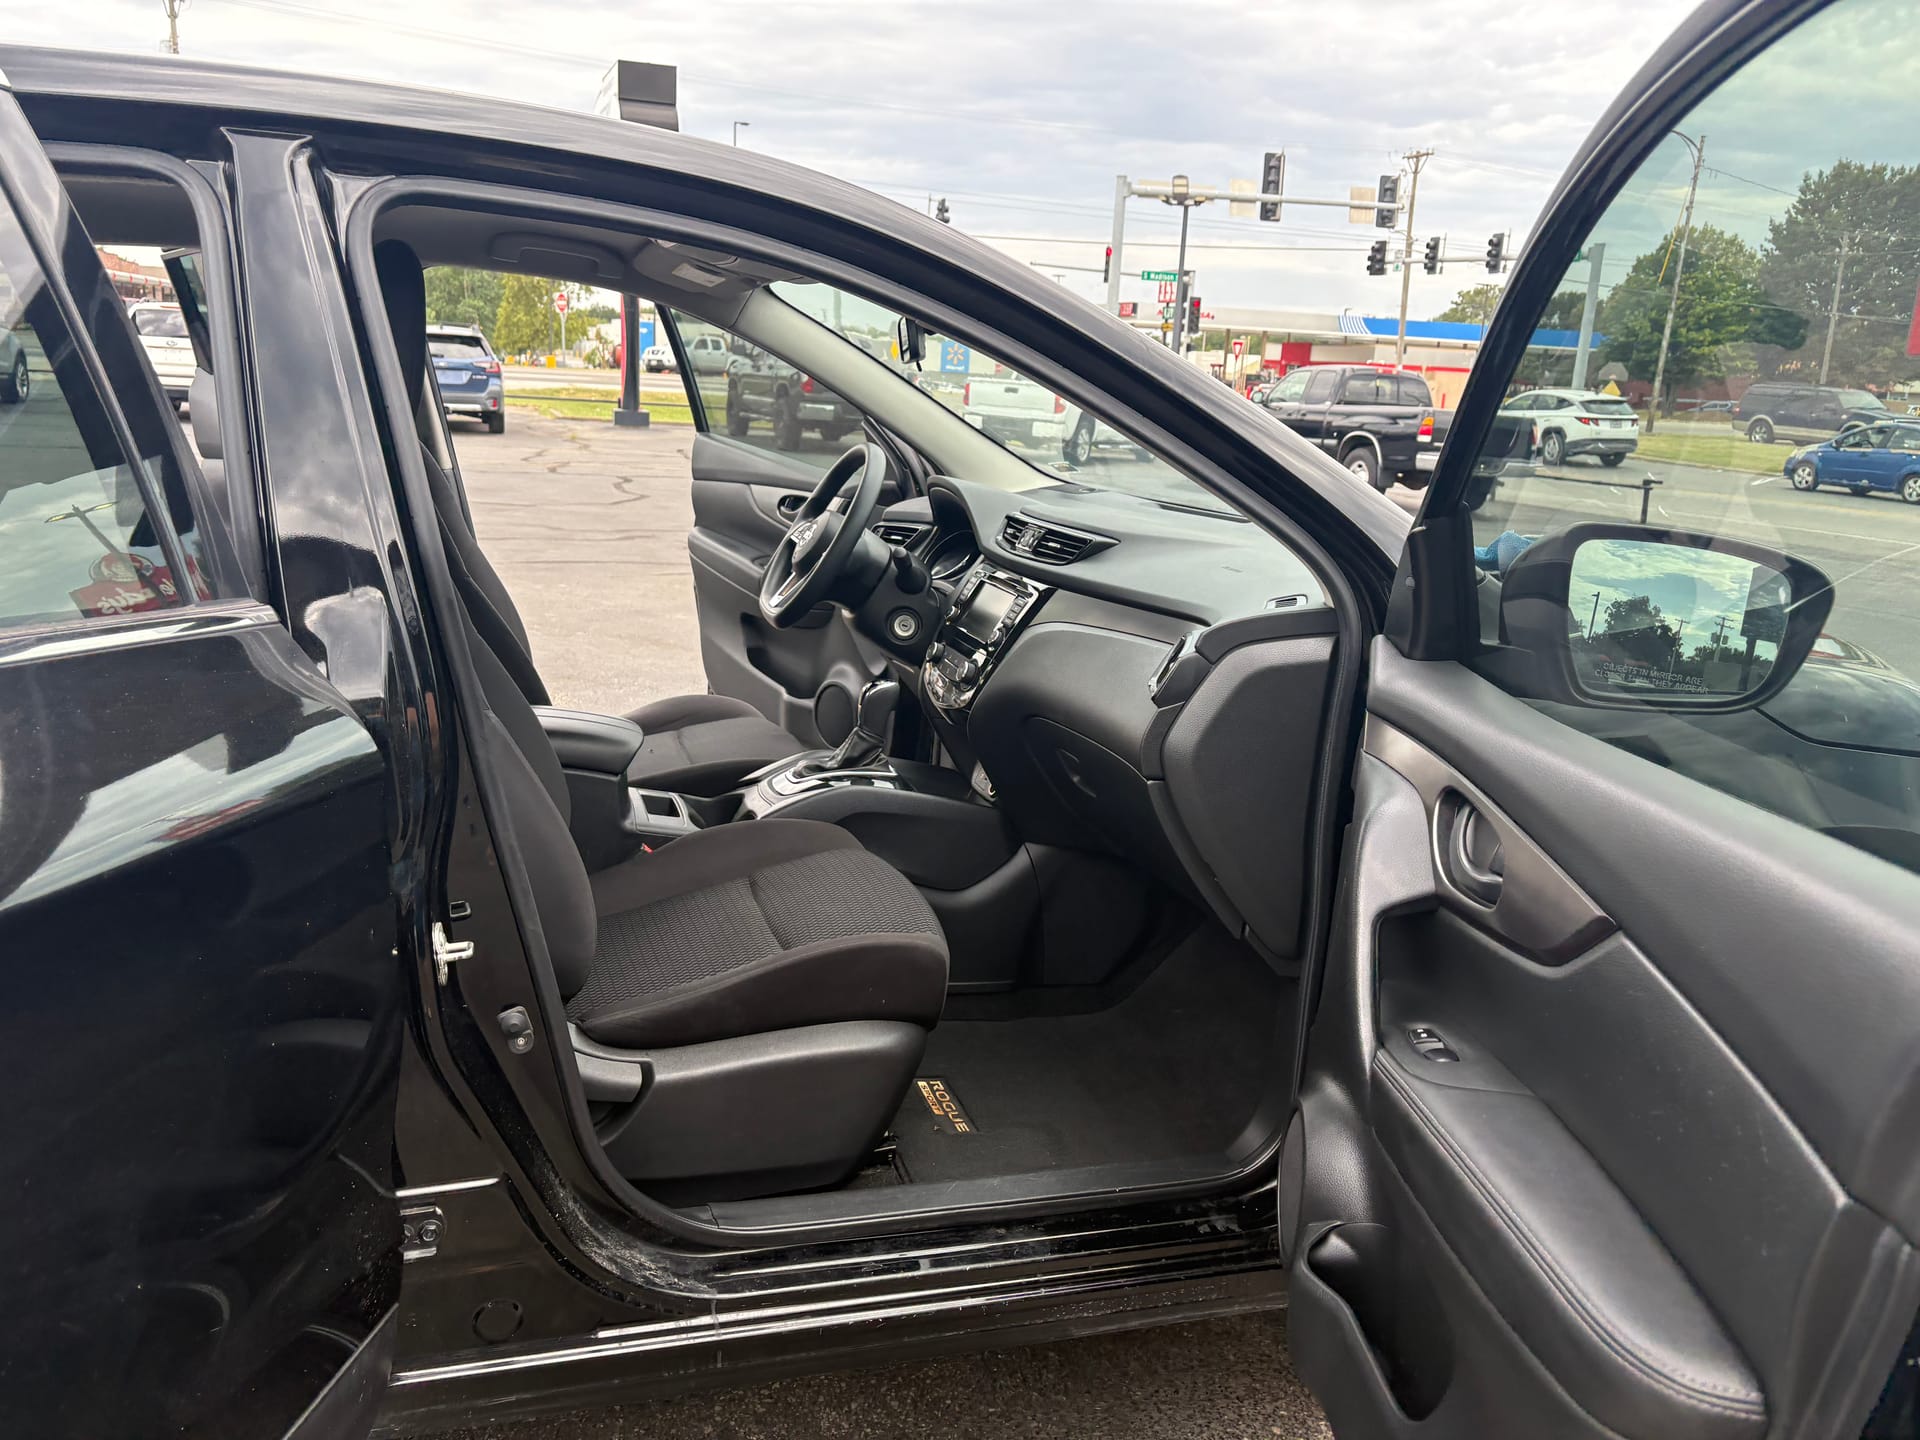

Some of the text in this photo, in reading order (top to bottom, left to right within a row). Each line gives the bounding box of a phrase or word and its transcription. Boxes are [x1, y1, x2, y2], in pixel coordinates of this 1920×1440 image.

[1150, 271, 1174, 281] Madison
[1603, 662, 1704, 686] OBJECTS IN MIRROR ARE
[1651, 678, 1673, 689] THEY
[1674, 682, 1709, 694] APPEAR
[919, 1083, 943, 1114] SPORT
[929, 1080, 970, 1133] ROGUE
